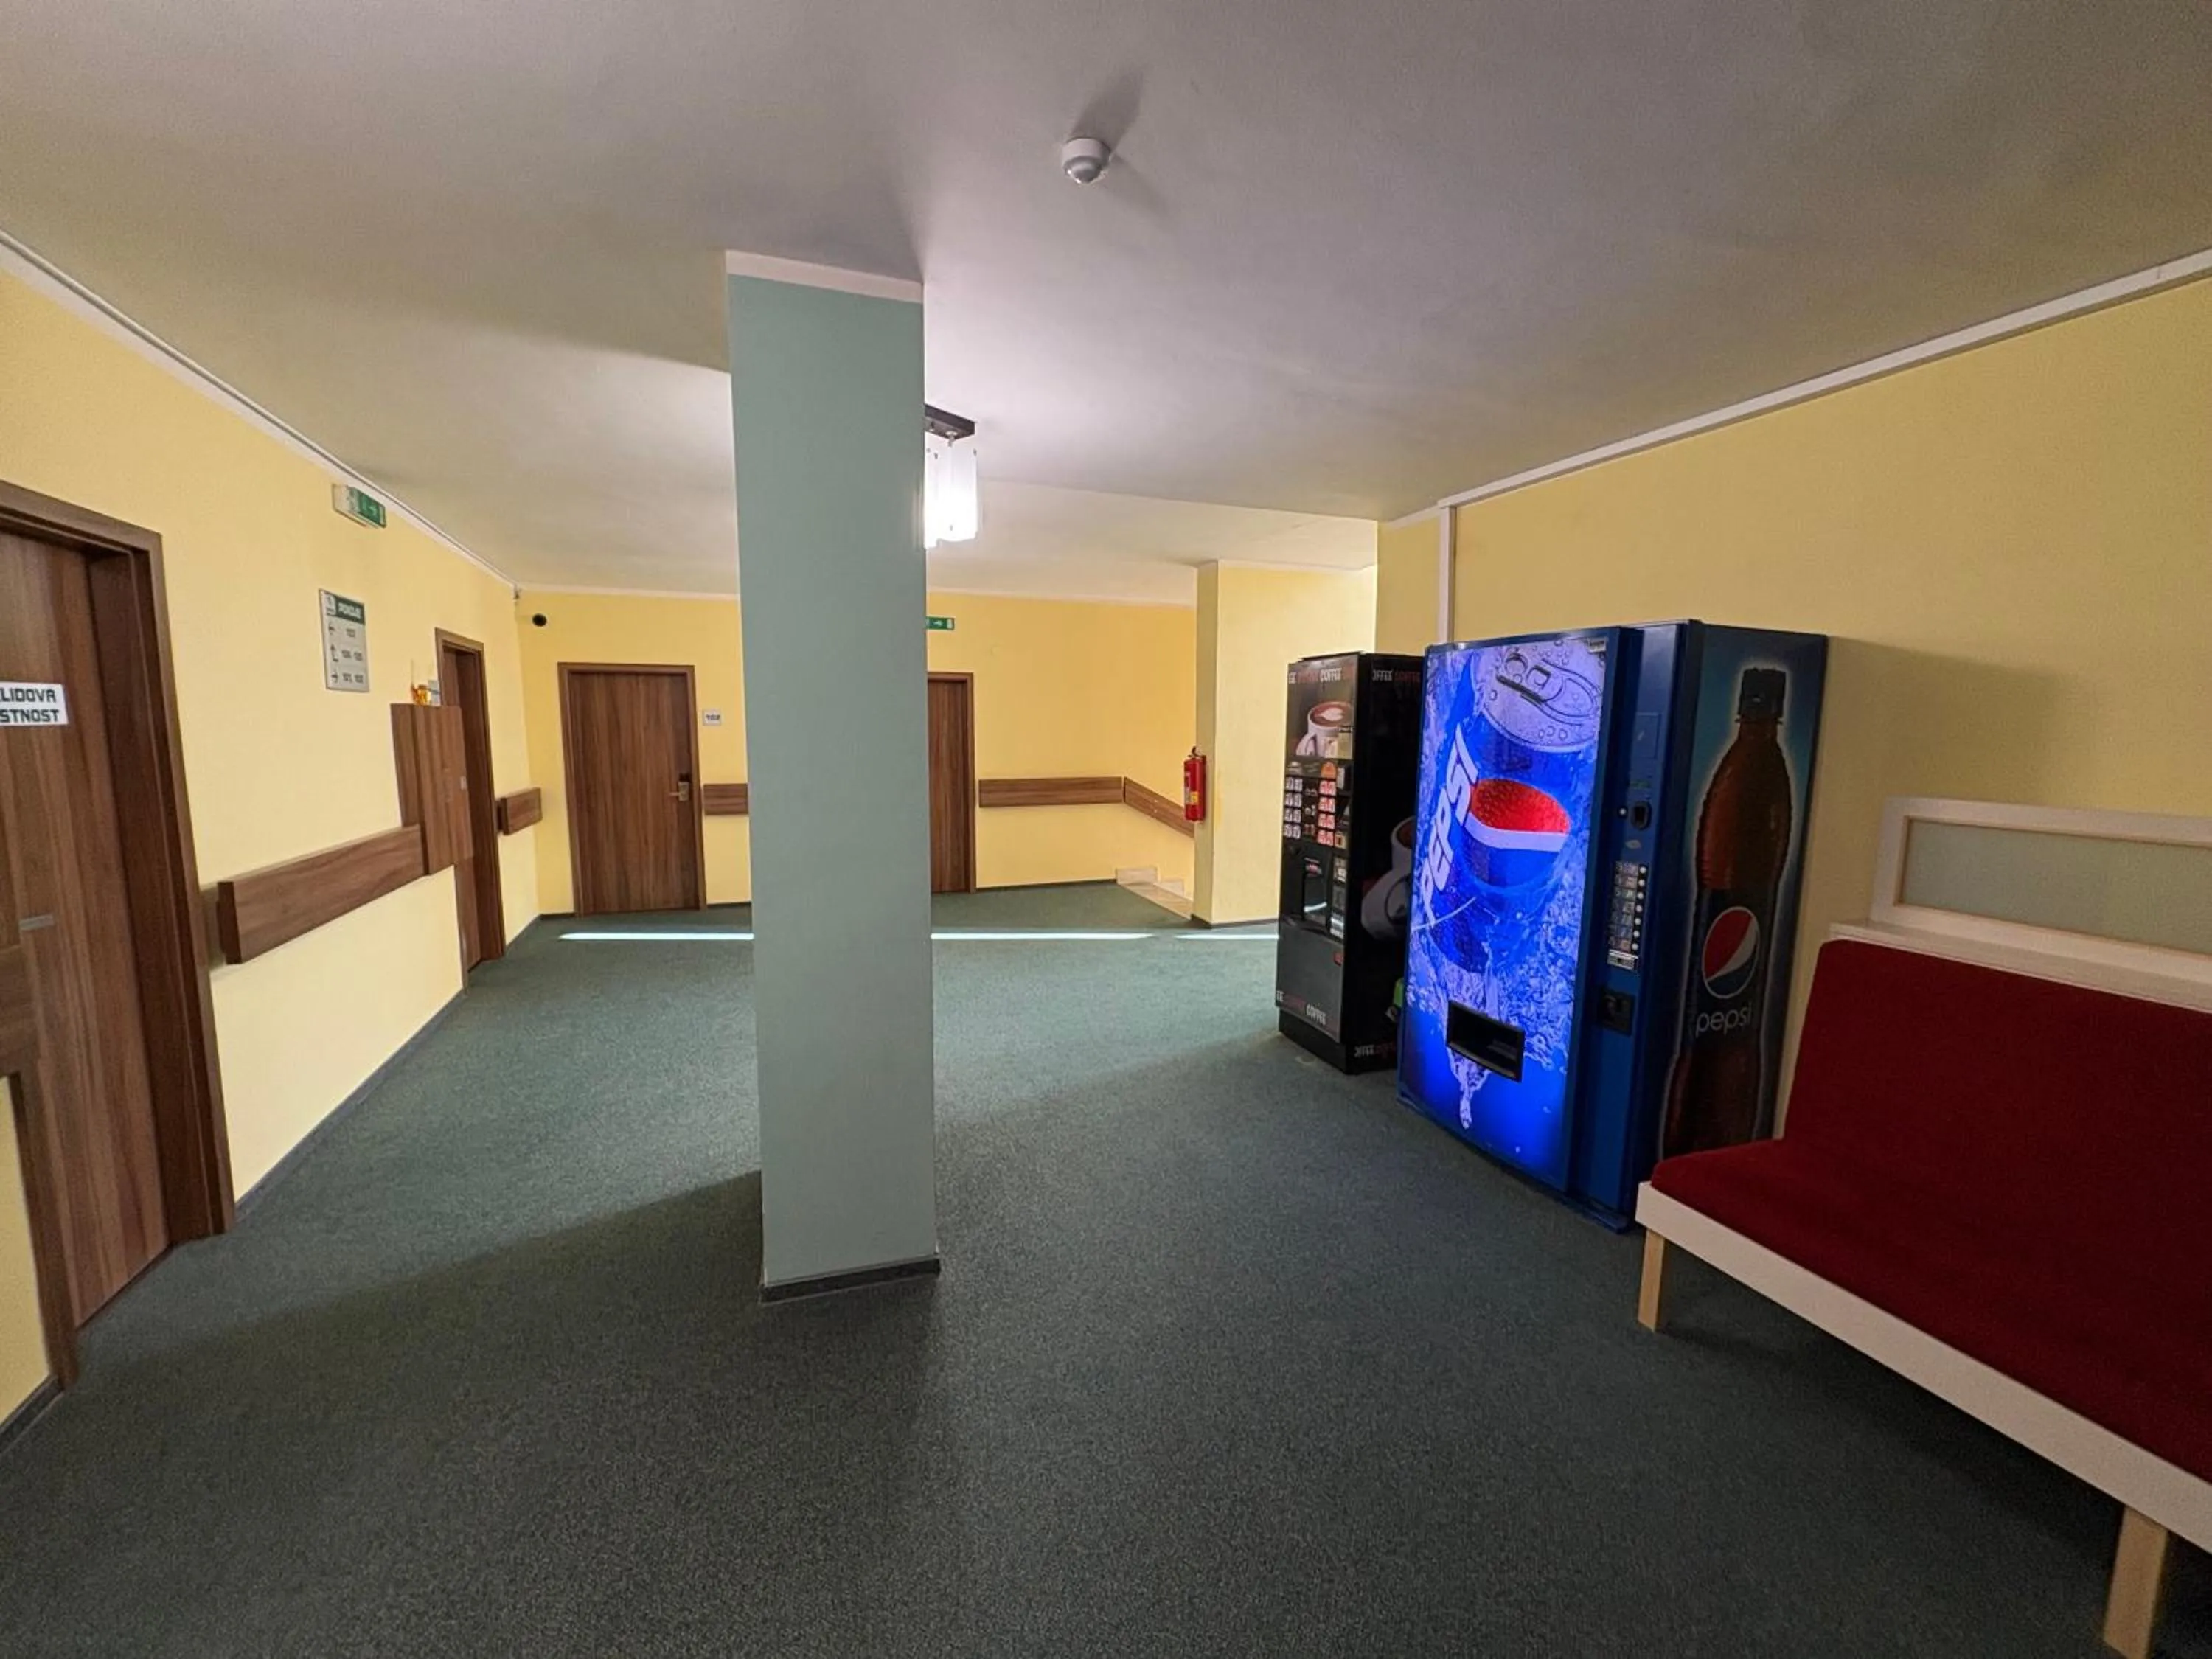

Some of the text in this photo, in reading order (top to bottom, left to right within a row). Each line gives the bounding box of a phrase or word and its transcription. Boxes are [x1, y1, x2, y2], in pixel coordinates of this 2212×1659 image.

[0, 688, 56, 703] LIDOVA
[1421, 722, 1478, 928] PEPSI
[1696, 1001, 1752, 1038] pepsi
